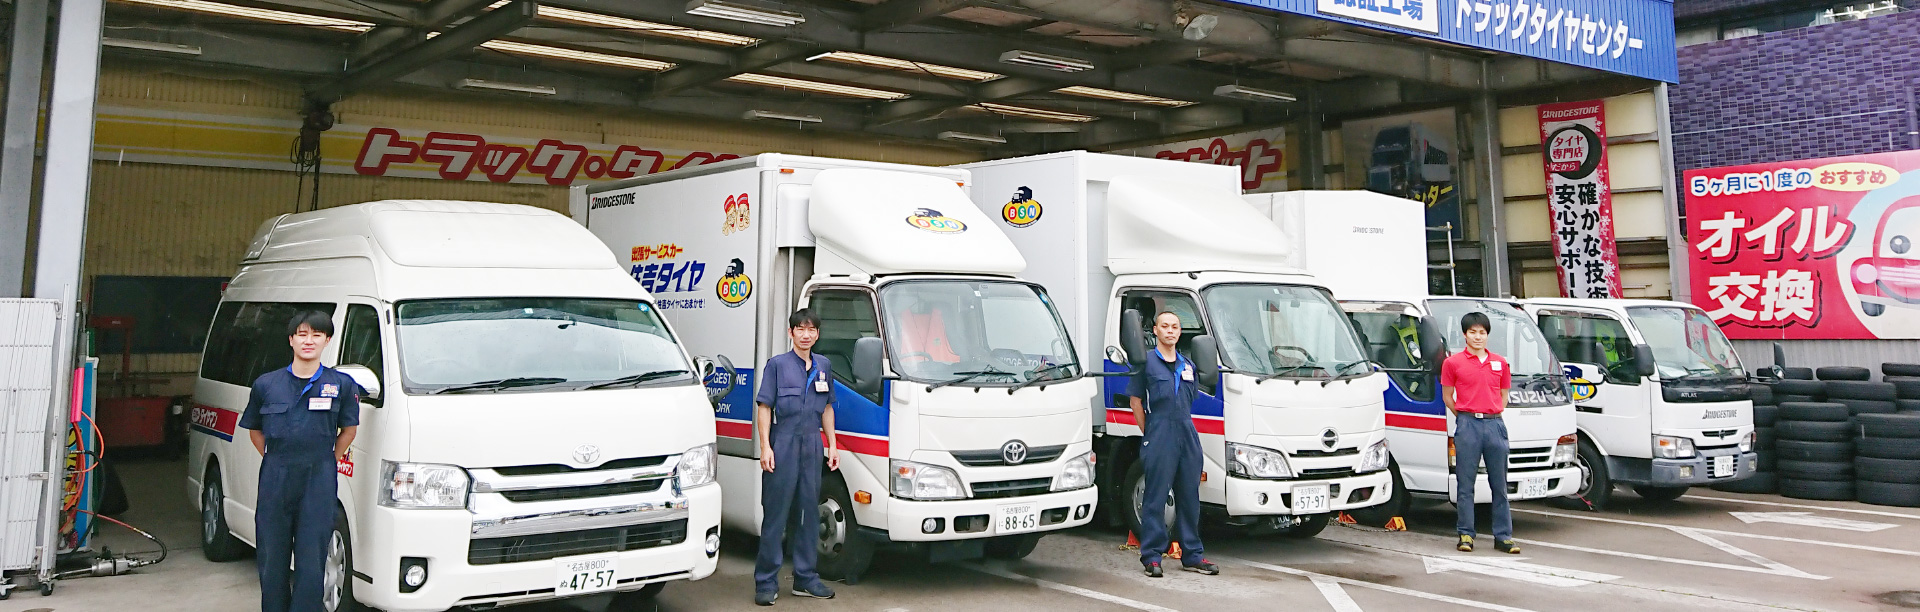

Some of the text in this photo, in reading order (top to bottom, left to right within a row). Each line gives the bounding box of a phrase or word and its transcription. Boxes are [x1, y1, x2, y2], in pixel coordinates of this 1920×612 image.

[1455, 0, 1644, 60] トラックタイヤセンター
[1542, 105, 1600, 119] BRIDGESTONE
[1553, 135, 1584, 148] タイヤ
[1552, 147, 1583, 160] 専門店
[1552, 161, 1577, 172] だから
[1819, 169, 1888, 185] おすすめ
[591, 192, 636, 210] BRIDGESTONE
[1008, 205, 1037, 220] BSN
[917, 219, 959, 229] BSN
[1696, 205, 1848, 258] オイル
[631, 243, 683, 262] 出張サービスカー
[721, 281, 749, 298] BSN
[1707, 269, 1814, 321] 交換
[1702, 408, 1738, 420] BRIDGESTONE
[1300, 495, 1325, 509] 57-97
[1005, 513, 1035, 530] 88-65
[572, 559, 606, 572] 名古屋800
[560, 569, 615, 591] ぬ 47-57
